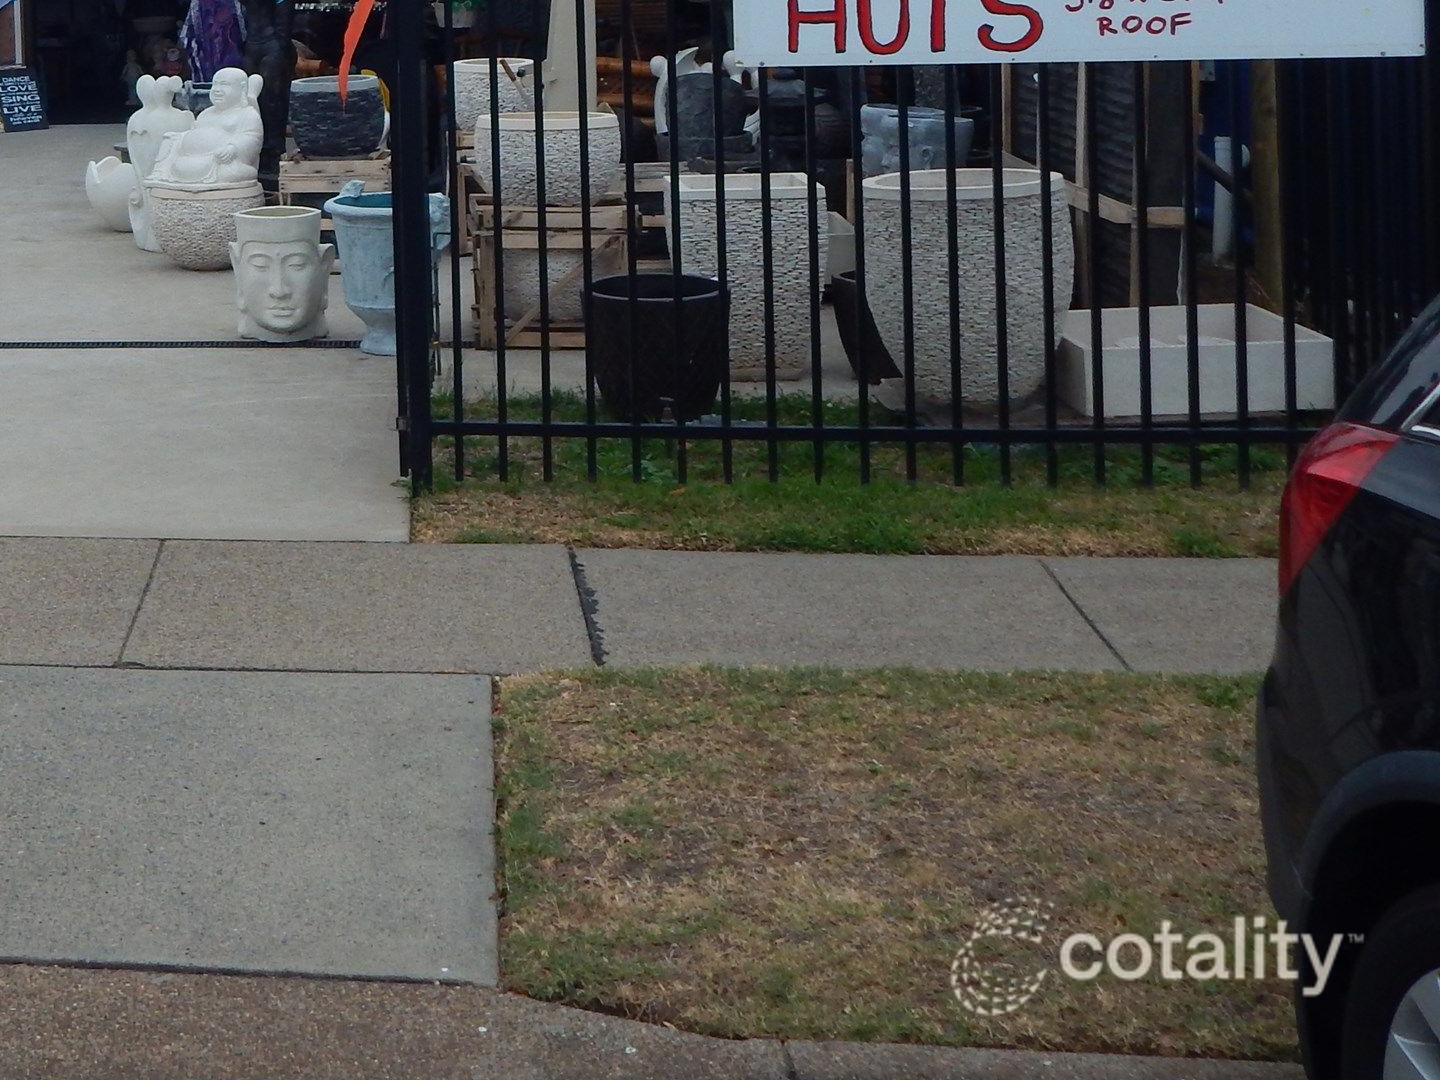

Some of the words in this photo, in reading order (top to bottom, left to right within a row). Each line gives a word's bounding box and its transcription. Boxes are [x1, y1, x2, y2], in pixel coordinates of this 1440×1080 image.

[1096, 12, 1192, 36] ROOF
[1, 94, 40, 103] SING
[2, 104, 43, 114] LIVE
